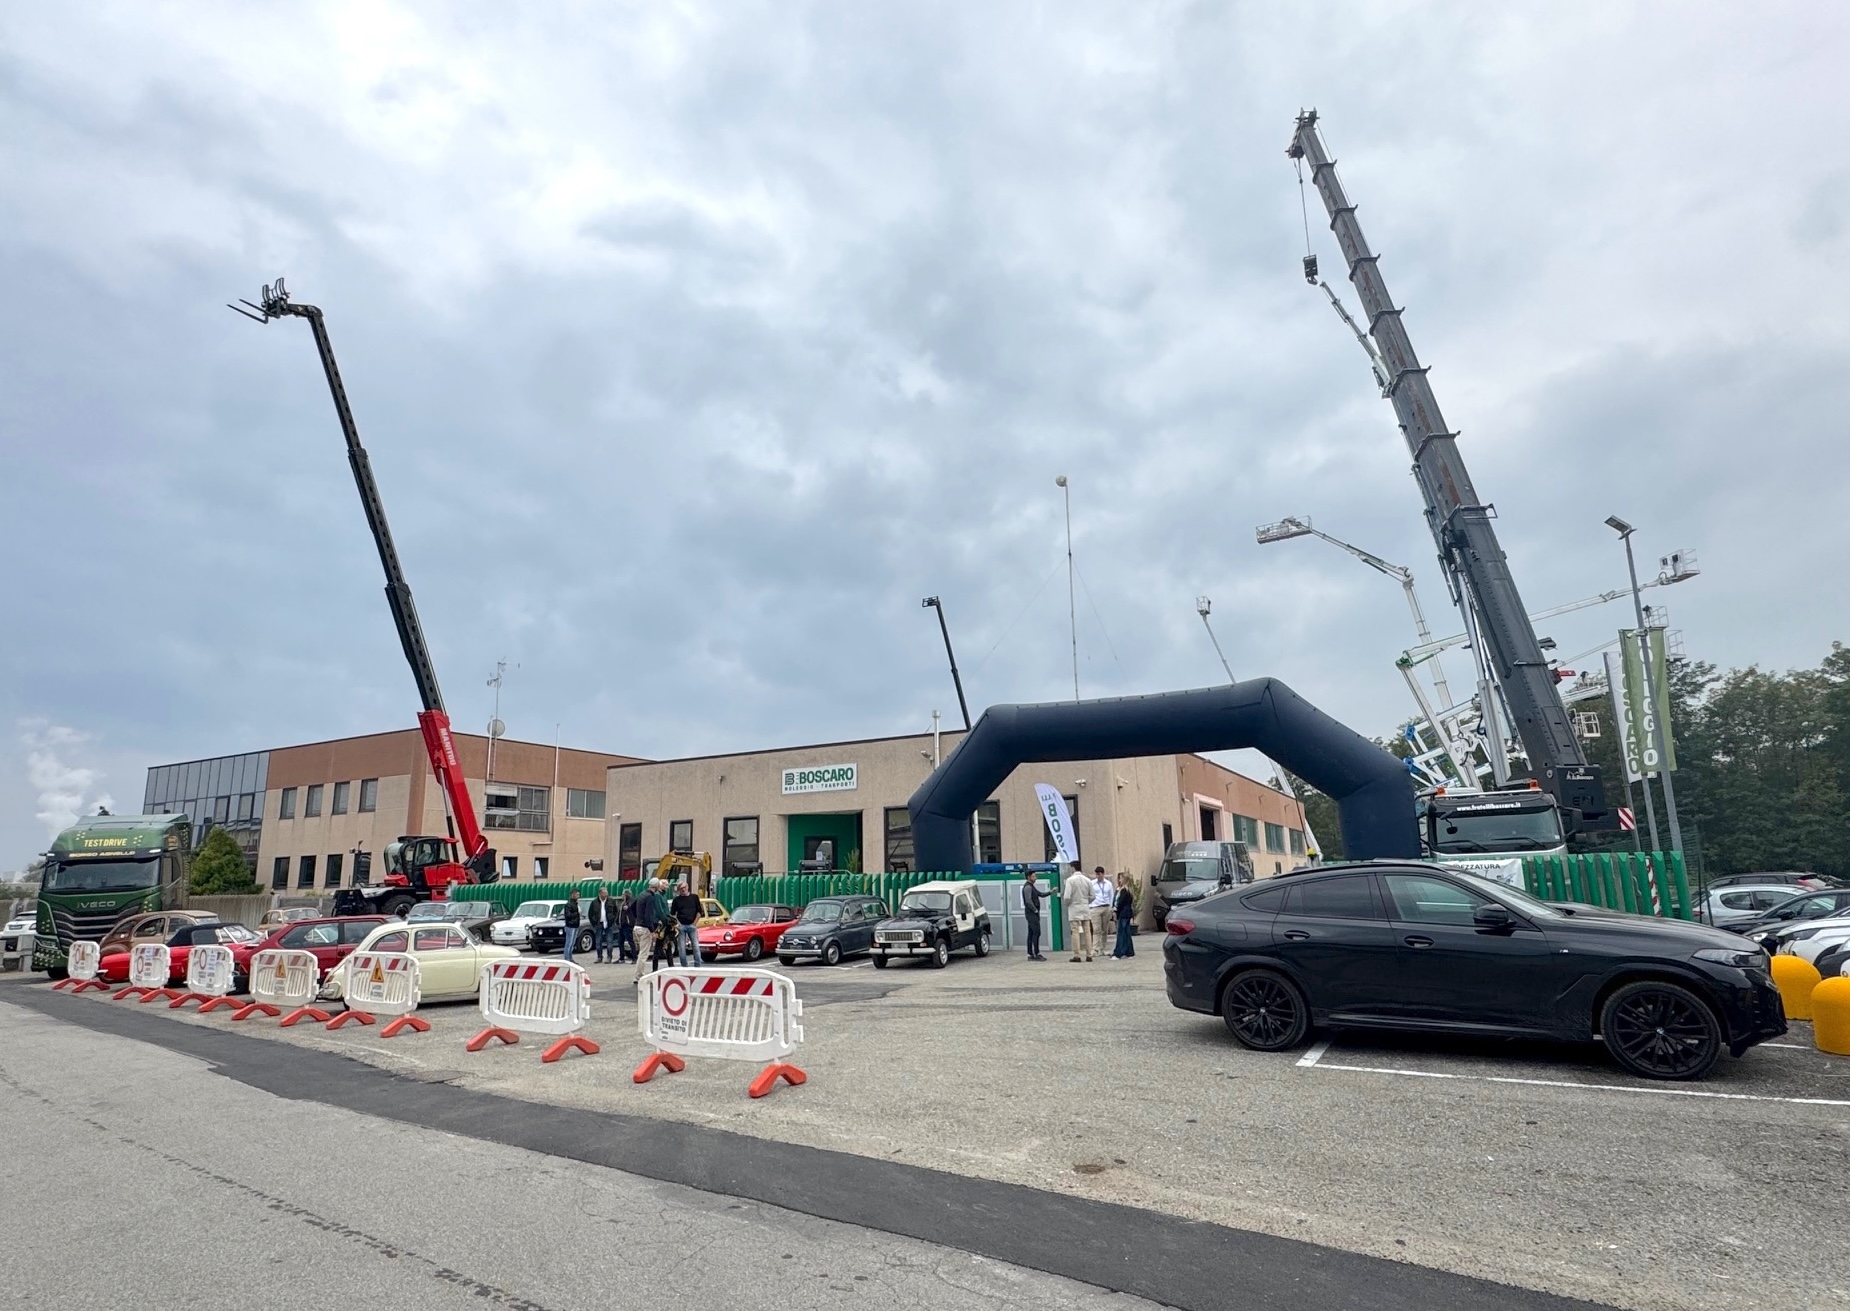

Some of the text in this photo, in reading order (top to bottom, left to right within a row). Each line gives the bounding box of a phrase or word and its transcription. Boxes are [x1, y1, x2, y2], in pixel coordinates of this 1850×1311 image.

[440, 728, 456, 765] MANITOU
[799, 767, 854, 785] BOSCARO
[76, 900, 116, 908] IVECO
[662, 1023, 686, 1032] TRANSITO
